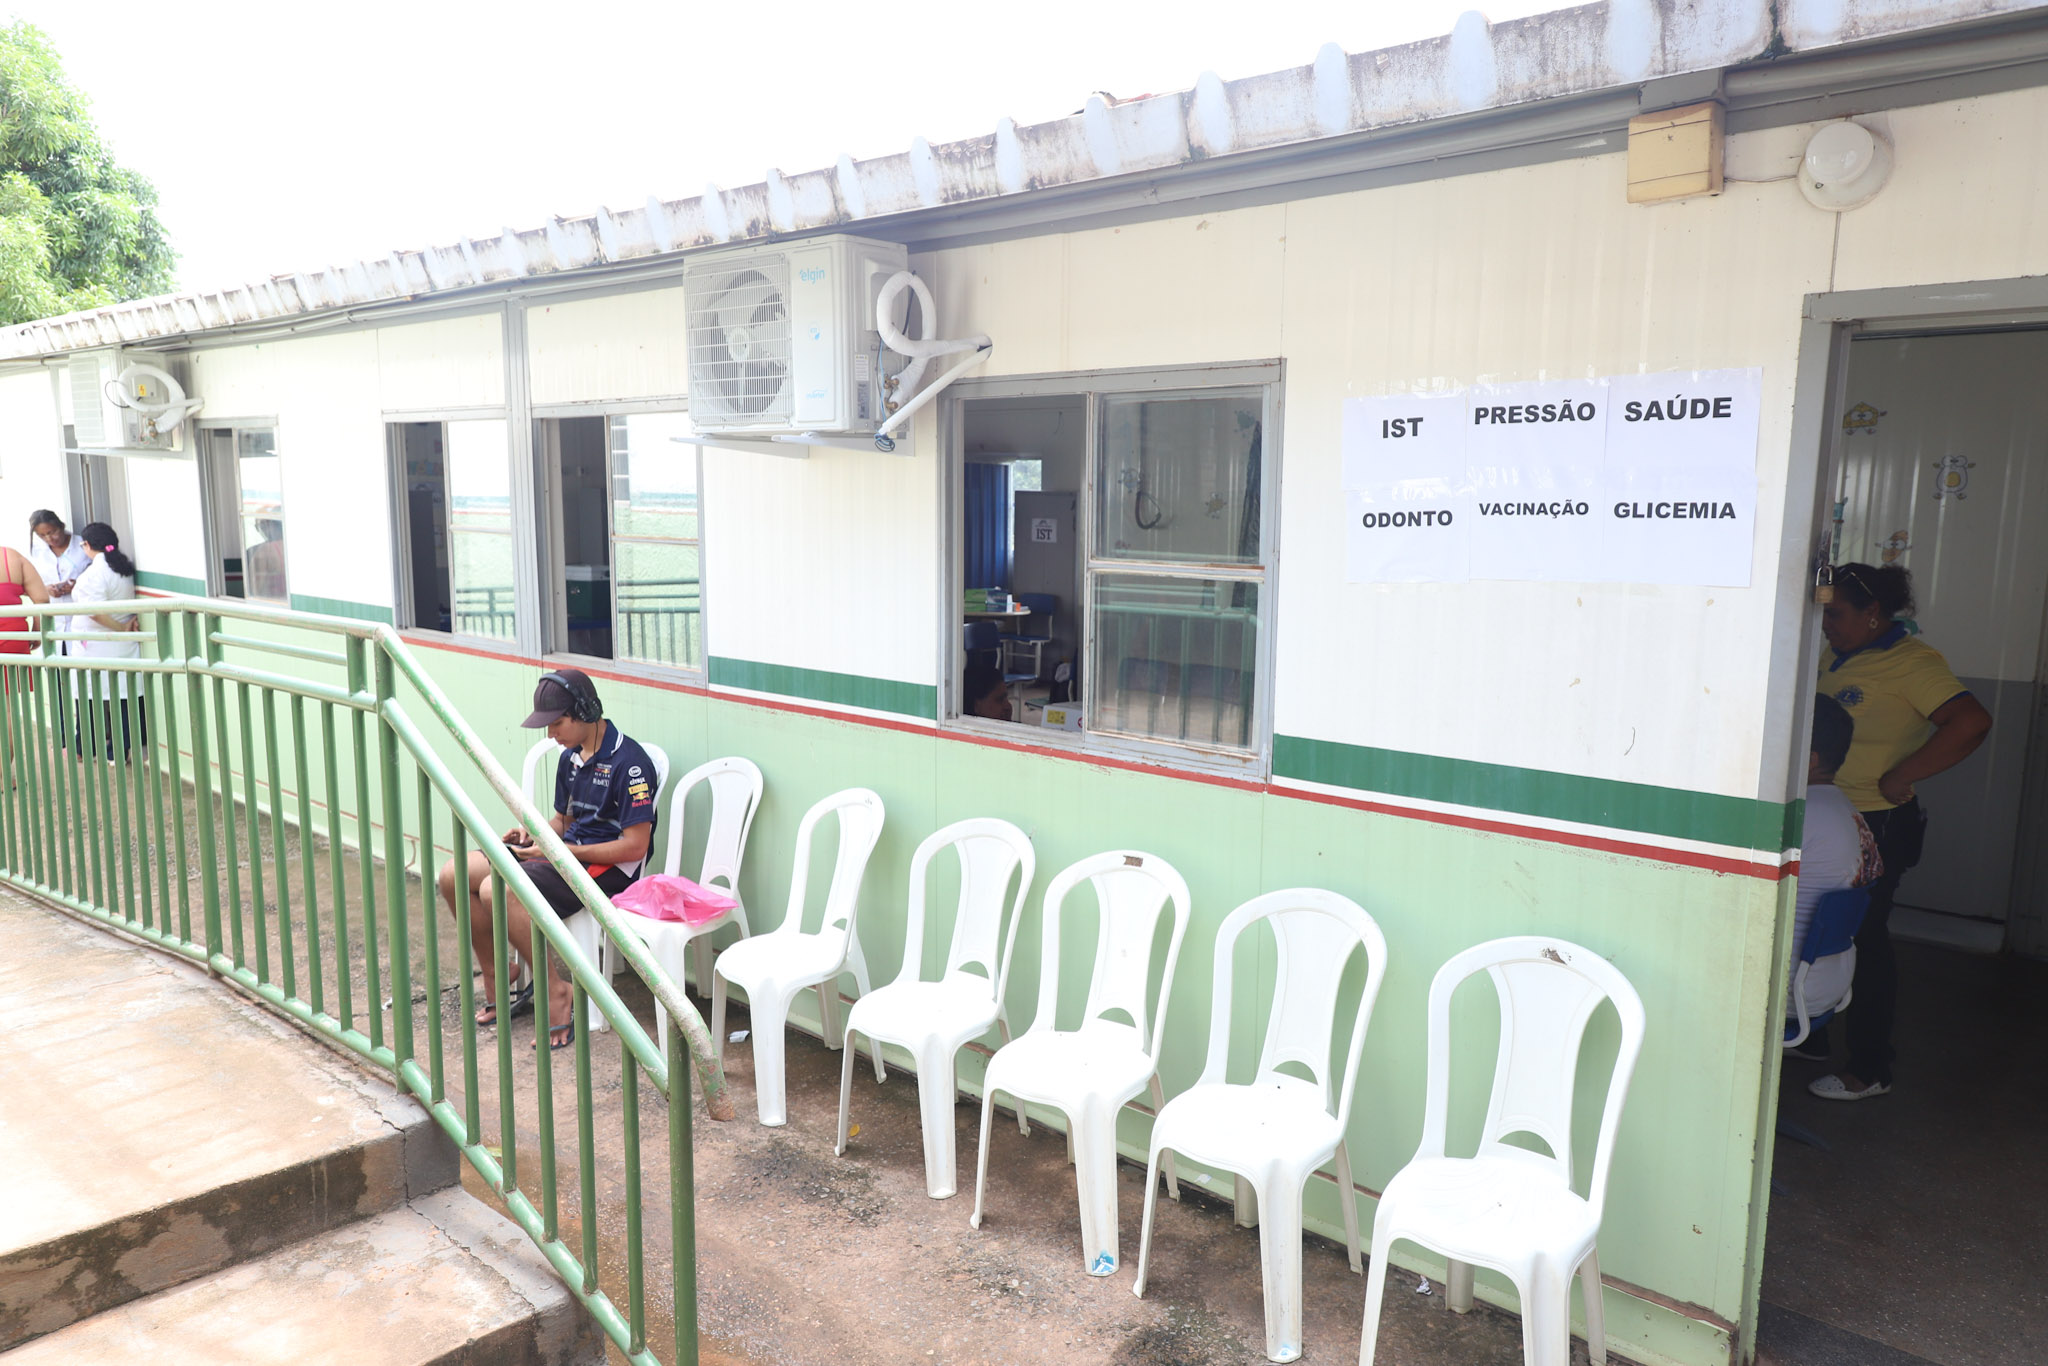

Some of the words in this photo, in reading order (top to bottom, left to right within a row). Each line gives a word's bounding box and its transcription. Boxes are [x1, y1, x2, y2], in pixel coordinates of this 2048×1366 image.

[800, 267, 825, 284] elgin
[1474, 399, 1597, 425] PRESSÃO
[1624, 394, 1733, 422] SAÚDE
[1382, 417, 1424, 439] IST
[1478, 499, 1590, 519] VACINAÇÃO
[1613, 502, 1737, 519] GLICEMIA
[1362, 510, 1454, 529] ODONTO
[1036, 528, 1053, 540] IST
